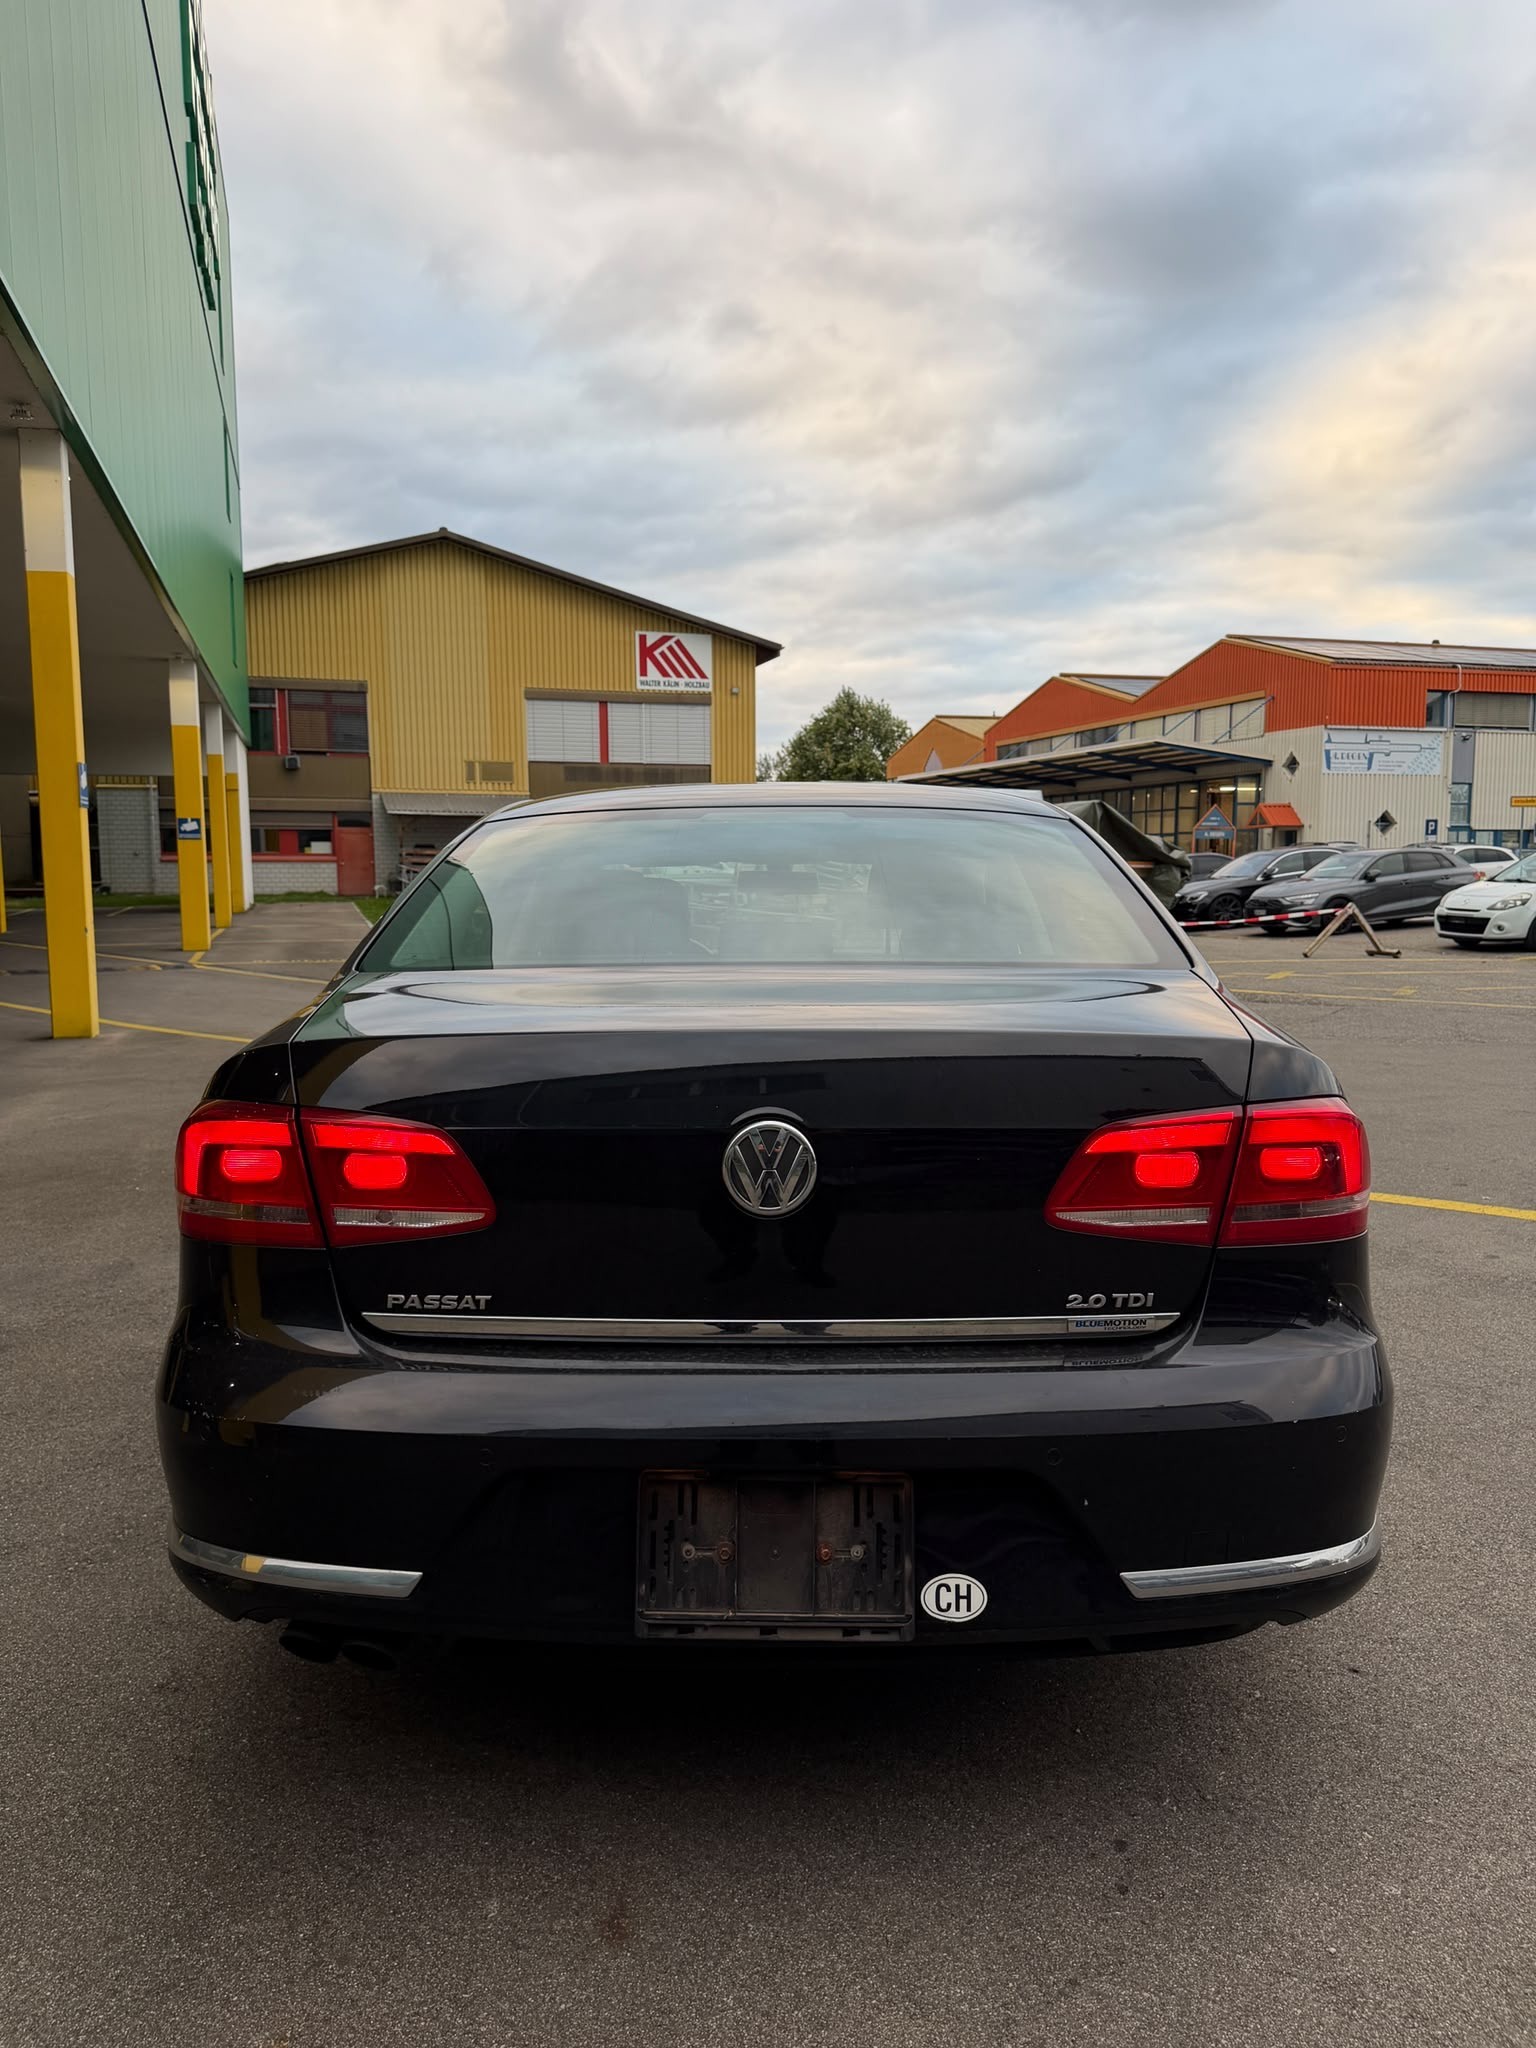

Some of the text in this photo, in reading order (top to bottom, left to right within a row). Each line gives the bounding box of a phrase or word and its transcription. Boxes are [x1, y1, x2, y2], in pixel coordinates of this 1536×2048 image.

[640, 680, 662, 688] WALTER
[684, 681, 710, 689] HOLZBAU
[1428, 821, 1436, 834] P
[387, 1294, 492, 1310] PASSAT
[1112, 1292, 1154, 1308] TDI
[1075, 1318, 1147, 1328] BLUEMOTION
[935, 1582, 971, 1613] CH
